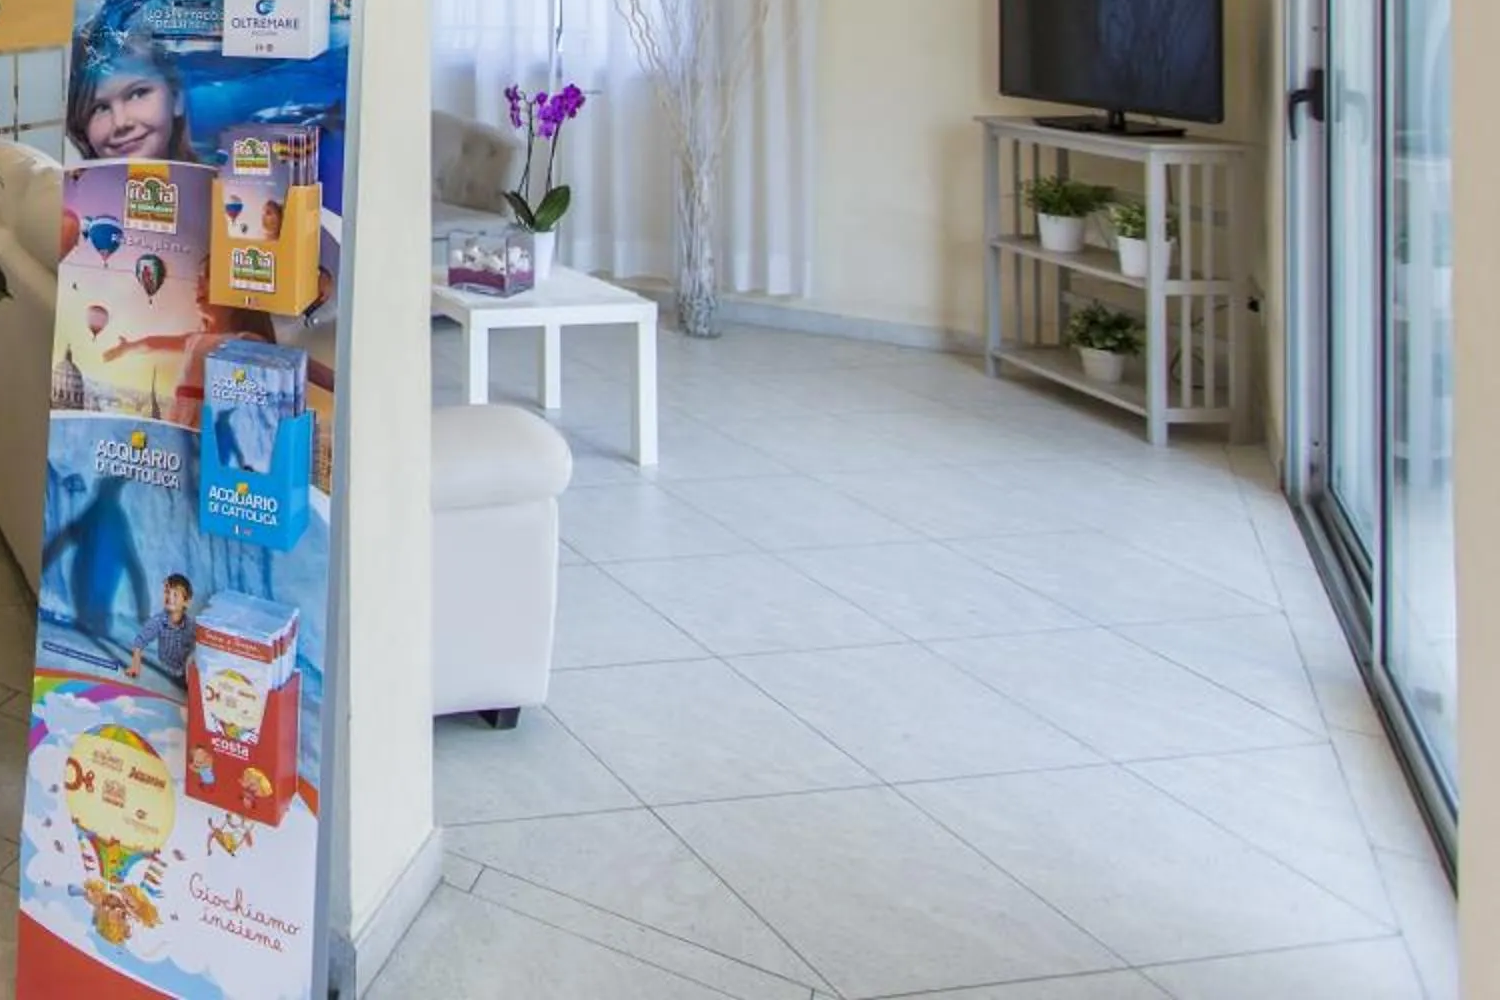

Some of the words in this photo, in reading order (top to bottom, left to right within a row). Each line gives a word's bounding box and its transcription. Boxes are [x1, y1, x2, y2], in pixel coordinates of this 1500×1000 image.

[232, 17, 299, 31] OLTREMARE
[97, 440, 181, 471] ACQUARIO
[110, 463, 180, 489] CATTOLICA
[209, 485, 278, 512] ACQUARIO
[209, 501, 219, 514] DI
[220, 503, 278, 525] CATTOLICA
[189, 872, 300, 935] Giochiamo
[199, 911, 284, 953] insieme
